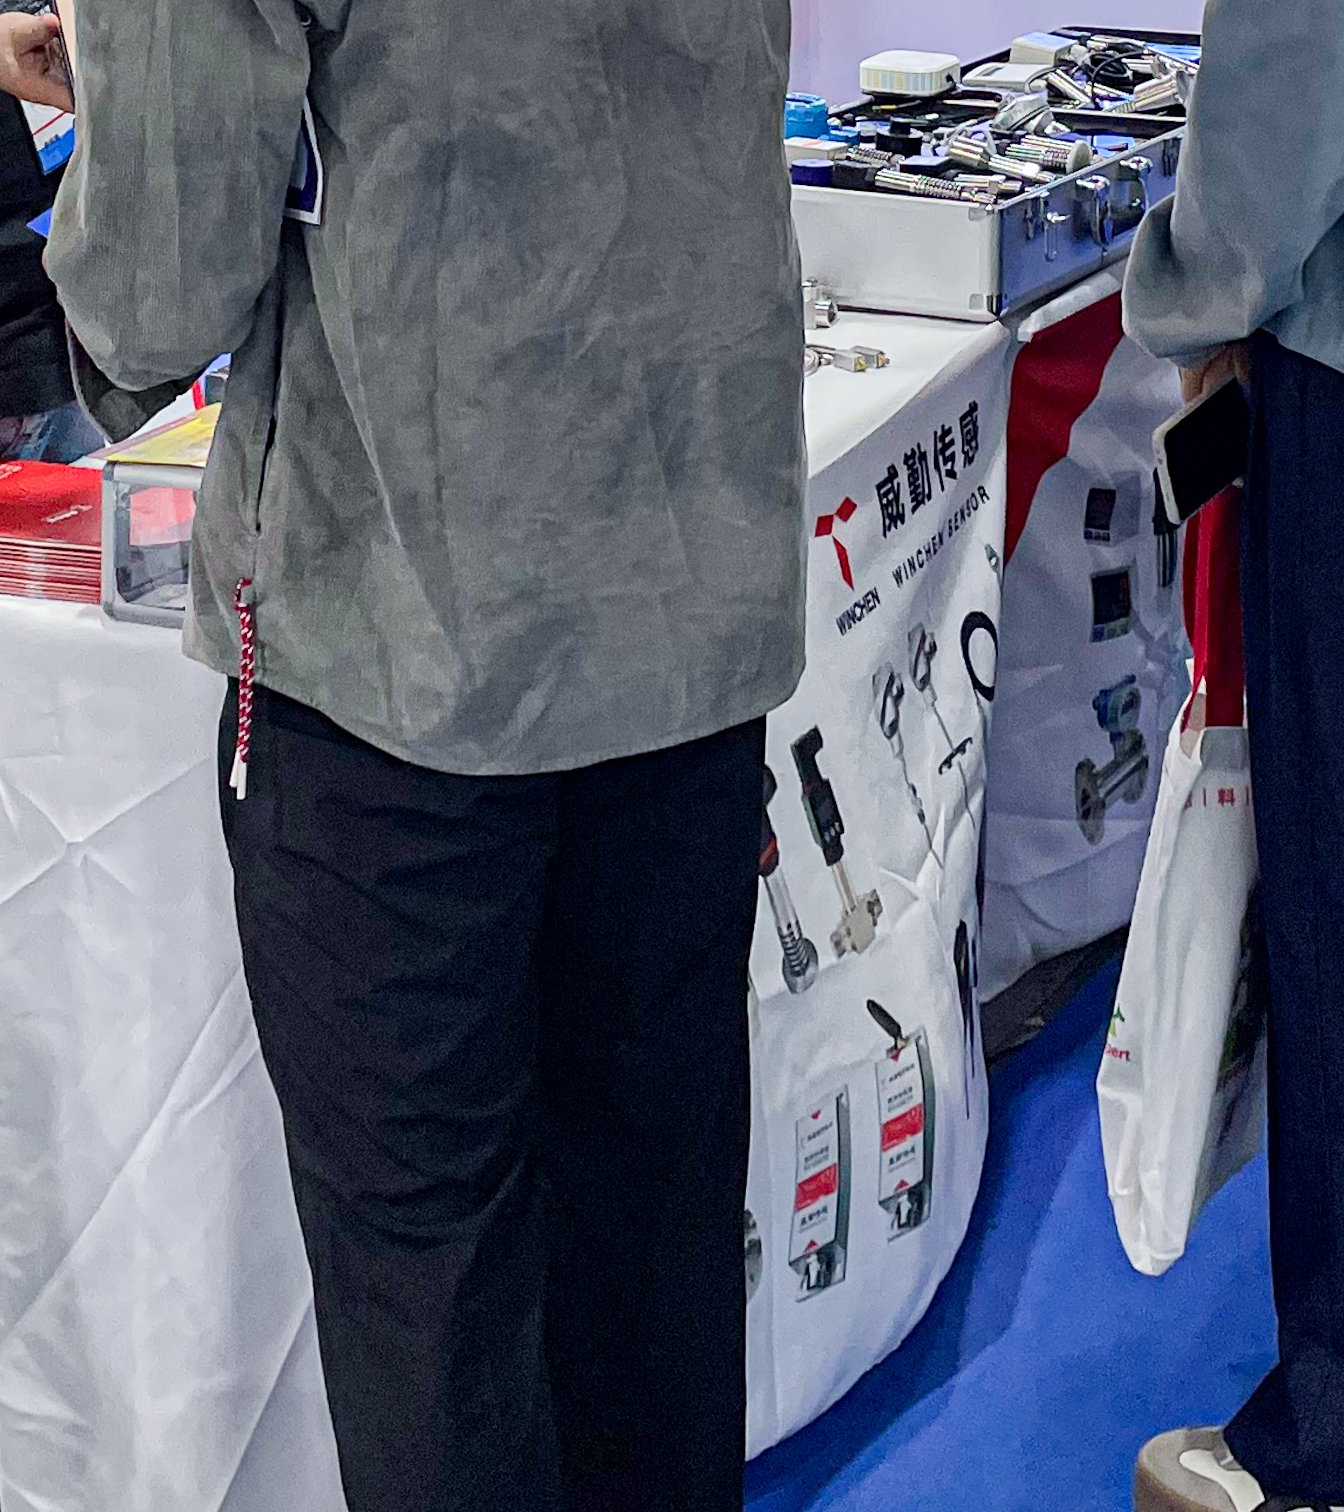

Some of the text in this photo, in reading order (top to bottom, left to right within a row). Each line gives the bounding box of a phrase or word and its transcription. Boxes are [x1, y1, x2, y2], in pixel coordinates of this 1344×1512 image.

[875, 399, 979, 540] 威勤传感
[891, 484, 991, 589] WINCHEN SENSOR
[835, 585, 881, 637] WINCHEN
